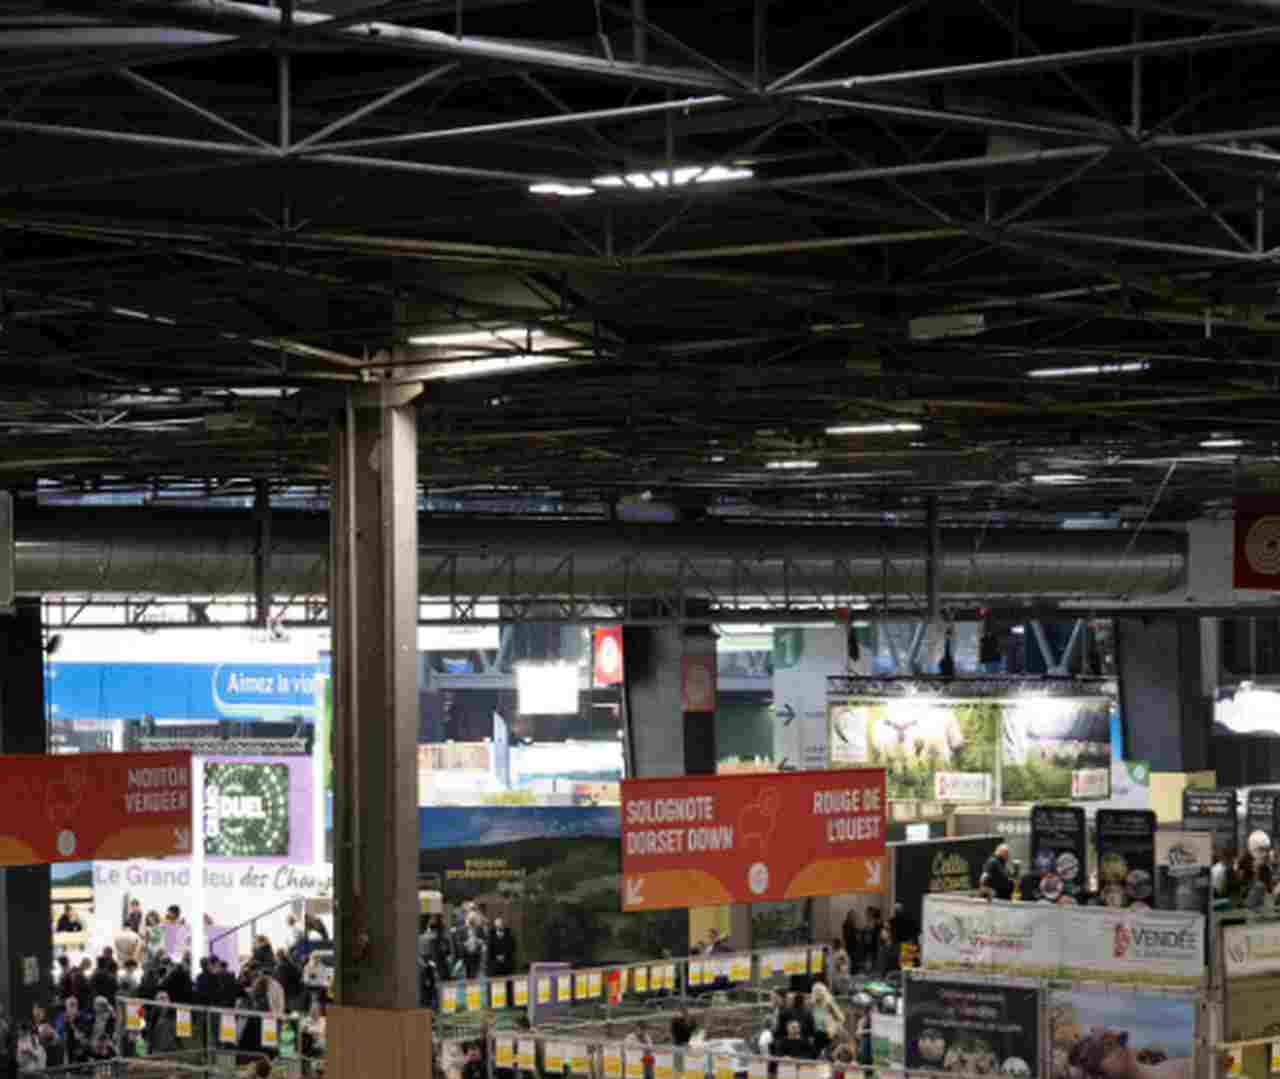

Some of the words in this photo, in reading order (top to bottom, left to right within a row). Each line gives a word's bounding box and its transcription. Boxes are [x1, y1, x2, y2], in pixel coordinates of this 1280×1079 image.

[128, 768, 188, 787] MOUTON
[221, 796, 267, 820] DUEL
[626, 796, 713, 825] SOLOGNOTE
[813, 788, 858, 814] ROUGE
[862, 786, 881, 811] DE
[626, 826, 684, 853] DORSET
[687, 823, 733, 851] DOWN
[827, 816, 881, 843] L'OUEST
[95, 865, 121, 886] Le
[125, 865, 191, 887] Grand
[1131, 921, 1197, 949] VENDÉE
